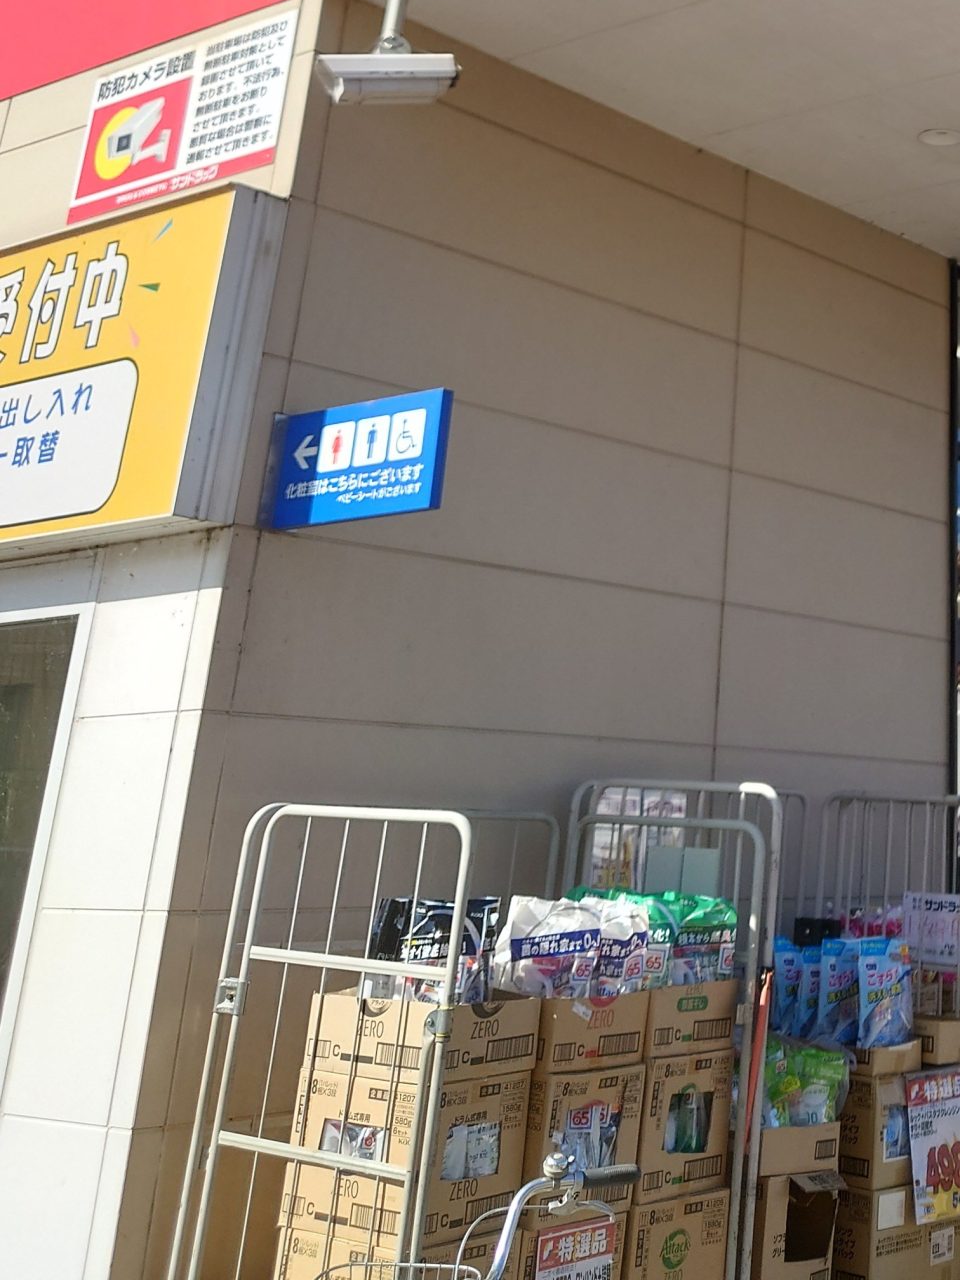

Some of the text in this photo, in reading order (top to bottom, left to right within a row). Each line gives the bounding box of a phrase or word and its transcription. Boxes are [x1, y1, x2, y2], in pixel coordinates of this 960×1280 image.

[97, 50, 196, 103] 防犯カメラ設置
[0, 382, 93, 430] 出し入れ
[285, 462, 425, 500] 化粧室はこちらにございます
[470, 1019, 500, 1040] ZERO
[586, 1009, 615, 1030] ZERO
[448, 1178, 479, 1202] ZERO
[557, 1227, 608, 1263] 特選品
